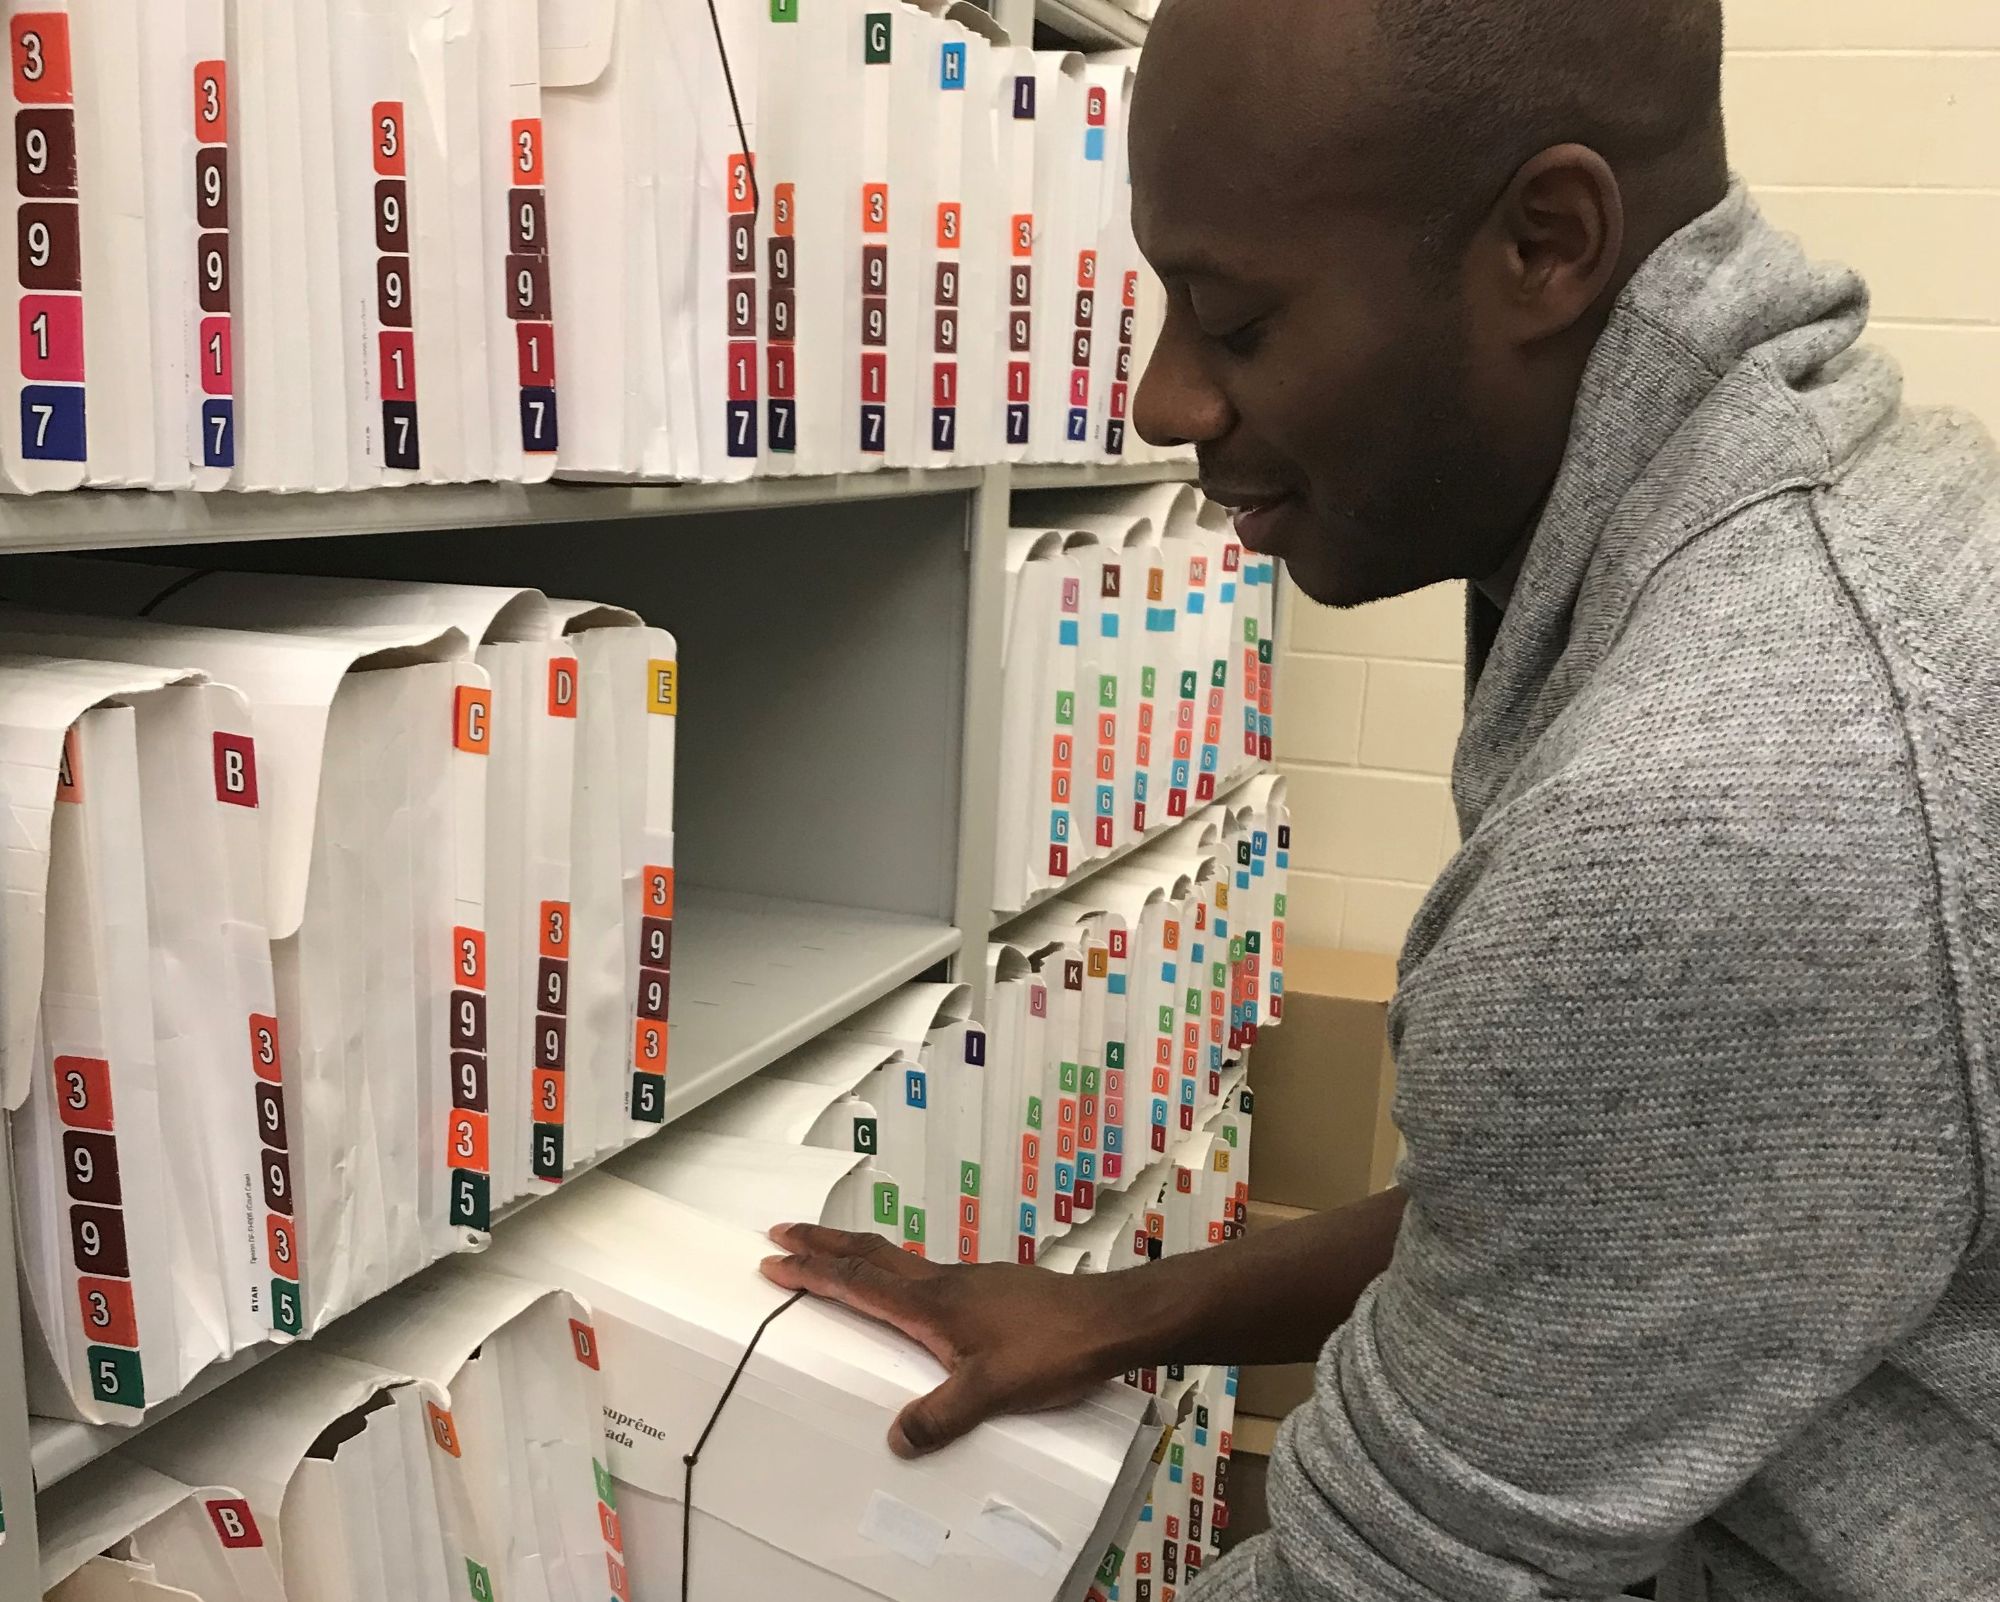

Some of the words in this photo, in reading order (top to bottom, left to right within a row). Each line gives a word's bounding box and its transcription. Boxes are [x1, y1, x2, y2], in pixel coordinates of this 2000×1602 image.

[871, 22, 887, 52] G
[22, 33, 43, 80] 3
[945, 52, 959, 80] H
[203, 79, 219, 121] 3
[1021, 83, 1029, 110] I
[1089, 97, 1102, 116] B
[26, 129, 48, 174] 9
[381, 118, 397, 156] 3
[518, 131, 533, 172] 3
[204, 165, 221, 207] 9
[734, 164, 747, 201] 3
[383, 196, 400, 233] 9
[520, 203, 535, 241] 9
[776, 198, 789, 224] 3
[870, 193, 884, 223] 3
[943, 211, 956, 239] 3
[1019, 220, 1032, 248] 3
[28, 222, 50, 267] 9
[735, 227, 749, 261] 9
[206, 251, 223, 292] 9
[775, 248, 789, 279] 9
[870, 258, 883, 287] 9
[1083, 257, 1094, 279] 3
[385, 272, 402, 309] 9
[517, 270, 533, 307] 9
[942, 271, 955, 299] 9
[1016, 273, 1027, 299] 9
[735, 292, 749, 326] 9
[775, 301, 788, 332] 9
[1080, 297, 1092, 319] 9
[33, 314, 47, 357] 1
[869, 309, 883, 338] 9
[941, 319, 954, 346] 9
[1015, 319, 1027, 344] 9
[210, 334, 222, 374] 1
[527, 336, 539, 373] 1
[1077, 337, 1089, 358] 9
[391, 349, 404, 390] 1
[736, 358, 747, 391] 1
[775, 359, 785, 389] 1
[869, 366, 879, 394] 1
[941, 373, 950, 399] 1
[31, 404, 53, 447] 7
[528, 401, 545, 439] 7
[734, 410, 750, 445] 7
[774, 407, 789, 439] 7
[867, 413, 882, 443] 7
[938, 414, 951, 442] 7
[1011, 410, 1023, 436] 7
[1072, 415, 1084, 436] 7
[210, 416, 227, 455] 7
[393, 416, 409, 455] 7
[1065, 585, 1077, 605] J
[1105, 571, 1116, 591] K
[557, 671, 572, 704] D
[658, 671, 670, 703] E
[1104, 681, 1114, 700] 4
[469, 703, 485, 741] C
[1060, 698, 1072, 718] 4
[1104, 720, 1114, 738] 0
[1058, 741, 1069, 761] 0
[1179, 737, 1188, 754] 0
[225, 749, 245, 792] B
[1102, 754, 1112, 773] 0
[1057, 777, 1067, 797] 0
[1101, 792, 1111, 810] 6
[1056, 817, 1066, 837] 6
[653, 876, 666, 905] 3
[549, 912, 563, 944] 3
[1113, 934, 1123, 952] B
[462, 939, 477, 976] 3
[650, 930, 665, 959] 9
[547, 972, 561, 1004] 9
[1069, 965, 1079, 984] K
[647, 982, 662, 1011] 9
[1034, 992, 1043, 1010] J
[460, 1000, 476, 1037] 9
[258, 1029, 274, 1064] 3
[545, 1029, 559, 1061] 9
[645, 1030, 659, 1058] 3
[67, 1072, 87, 1109] 3
[461, 1063, 477, 1100] 9
[910, 1078, 922, 1100] H
[1064, 1068, 1073, 1087] 4
[1085, 1071, 1095, 1089] 4
[543, 1080, 557, 1110] 3
[640, 1083, 654, 1112] 5
[263, 1098, 279, 1131] 9
[1031, 1104, 1040, 1123] 4
[457, 1121, 474, 1157] 3
[857, 1124, 871, 1147] G
[1028, 1141, 1036, 1159] 0
[74, 1147, 94, 1183] 9
[542, 1135, 556, 1167] 5
[269, 1164, 285, 1197] 9
[964, 1168, 974, 1188] 4
[1026, 1174, 1035, 1191] 0
[1059, 1169, 1068, 1187] 6
[460, 1181, 475, 1216] 5
[883, 1191, 892, 1215] F
[965, 1204, 974, 1223] 0
[909, 1213, 920, 1234] 4
[1024, 1210, 1033, 1228] 6
[80, 1220, 101, 1256] 9
[275, 1229, 290, 1262] 3
[961, 1236, 970, 1255] 0
[89, 1292, 109, 1326] 3
[280, 1293, 295, 1325] 5
[578, 1330, 590, 1357] D
[100, 1361, 119, 1394] 5
[436, 1418, 452, 1446] C
[601, 1405, 667, 1441] suprême
[604, 1427, 635, 1449] ada
[218, 1508, 245, 1538] B
[475, 1572, 487, 1598] 4
